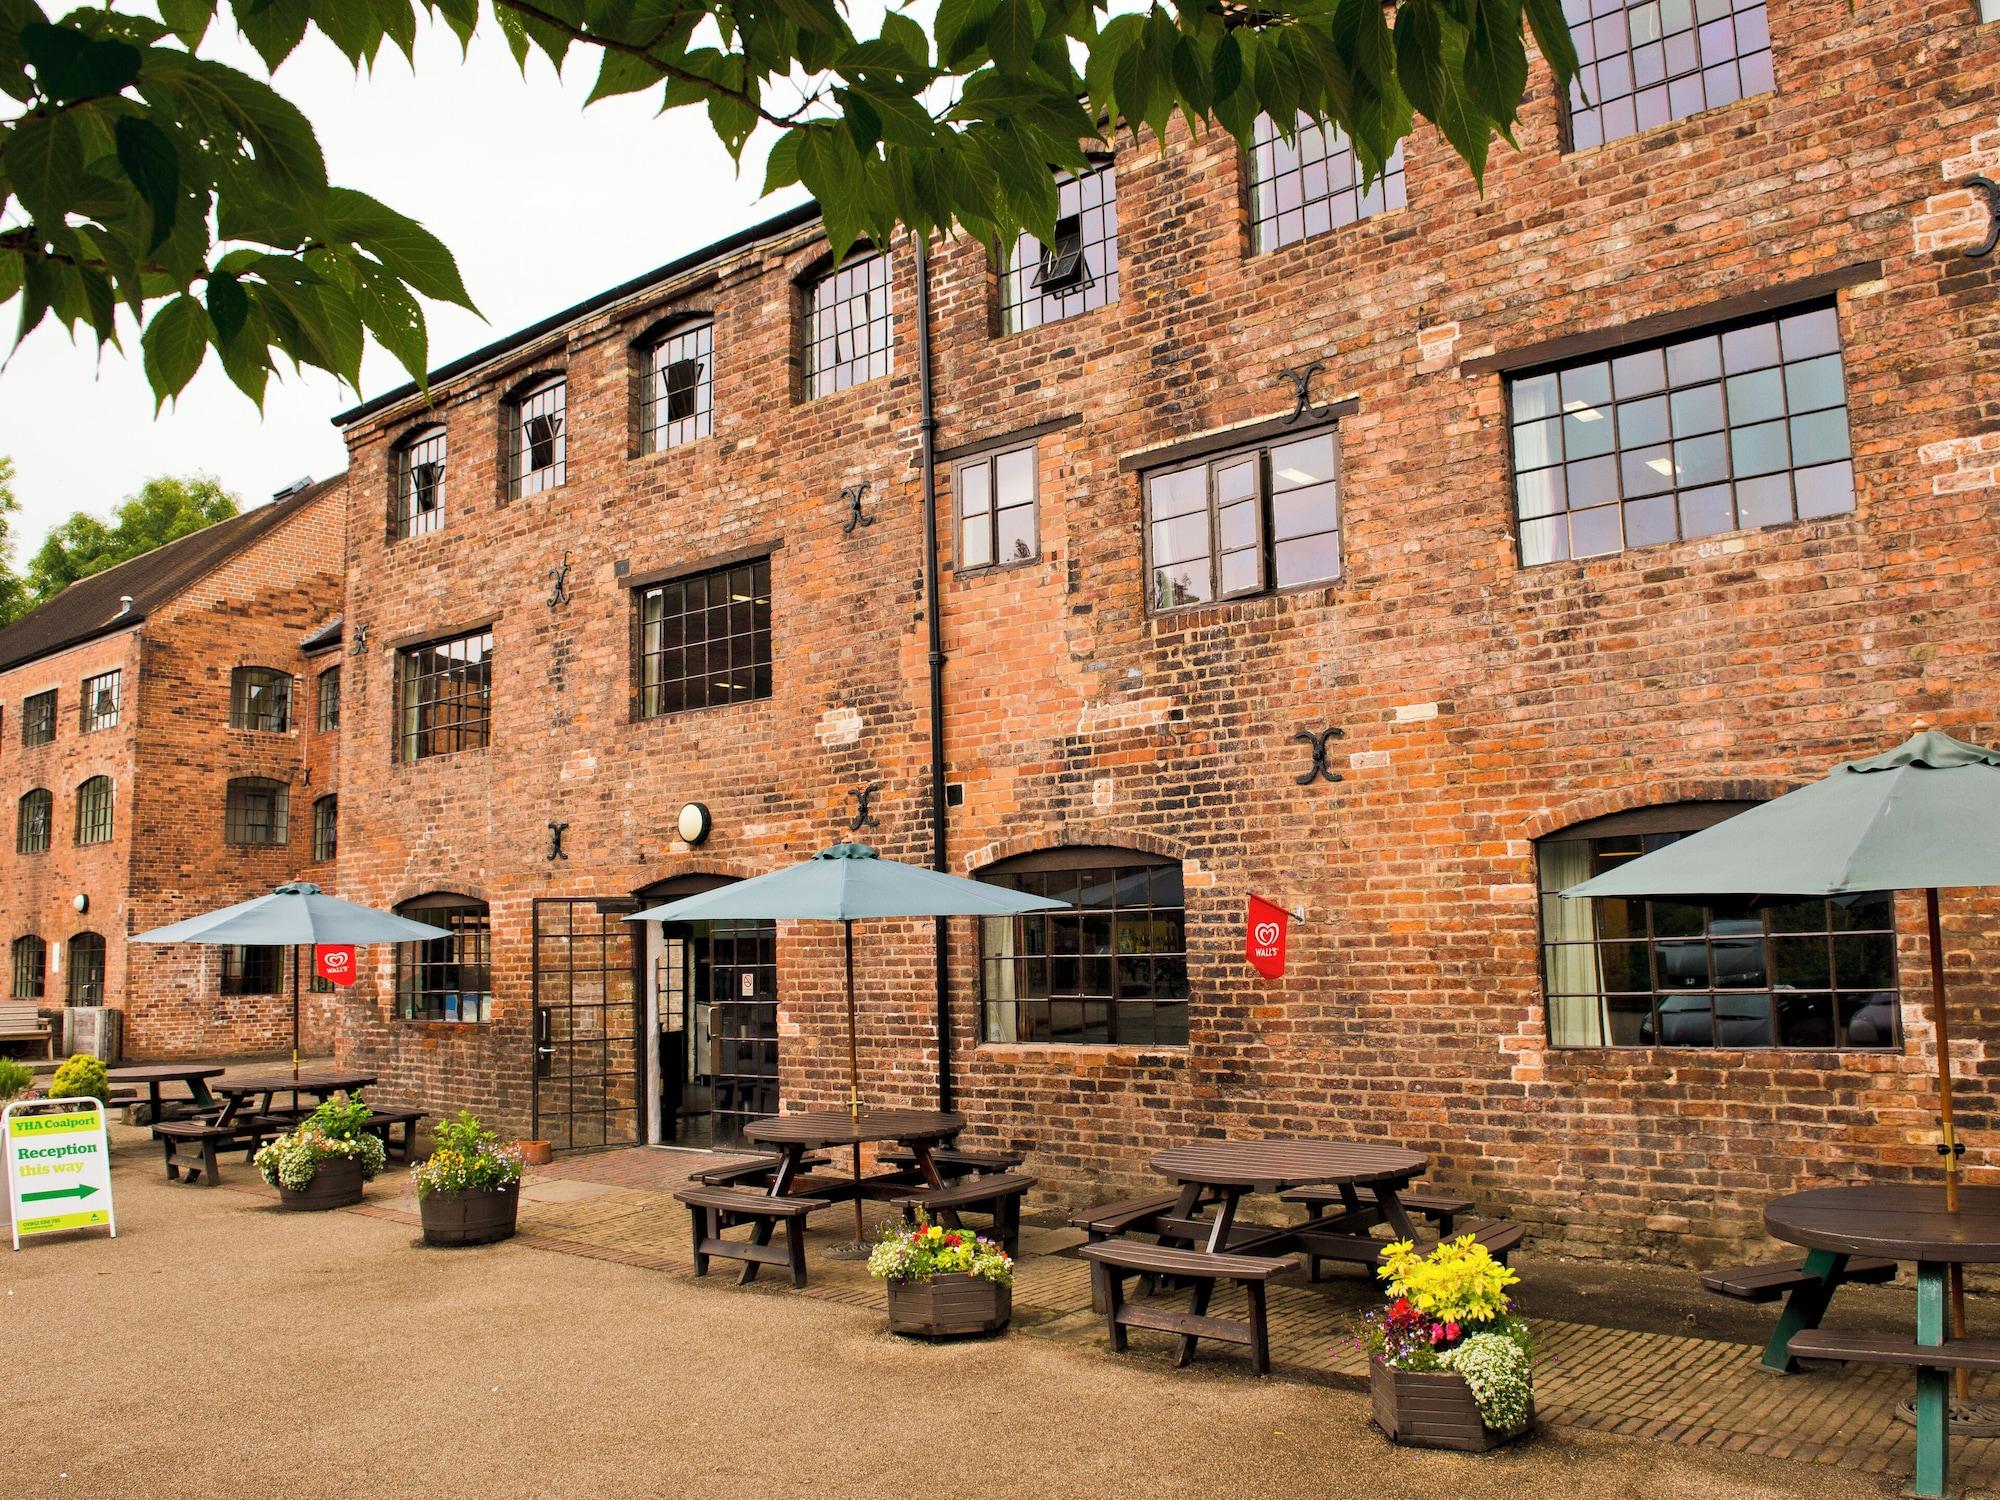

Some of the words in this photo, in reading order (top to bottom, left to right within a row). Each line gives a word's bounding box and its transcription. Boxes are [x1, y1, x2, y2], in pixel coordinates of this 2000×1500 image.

[1255, 947, 1278, 957] WALL'S
[326, 966, 348, 974] WALL'S
[16, 1121, 43, 1131] YHA
[44, 1117, 95, 1128] Coalport
[17, 1143, 97, 1160] Reception
[19, 1164, 50, 1177] this
[52, 1162, 84, 1173] way
